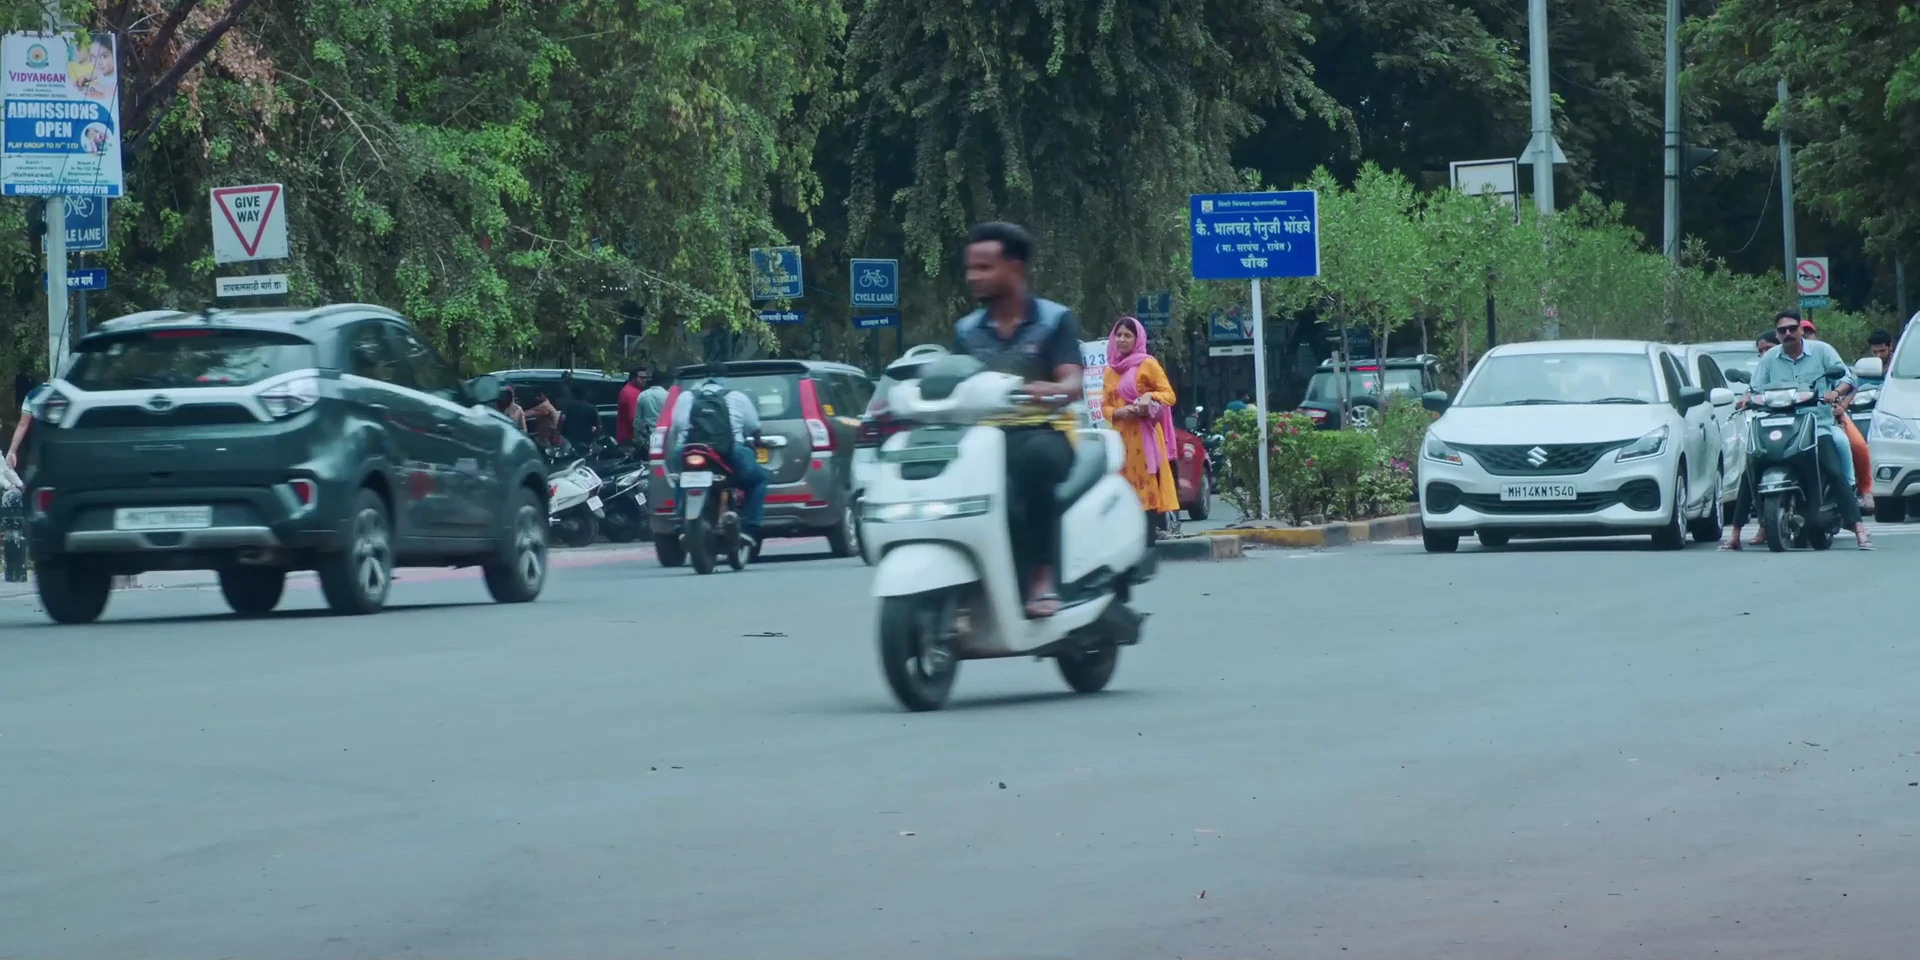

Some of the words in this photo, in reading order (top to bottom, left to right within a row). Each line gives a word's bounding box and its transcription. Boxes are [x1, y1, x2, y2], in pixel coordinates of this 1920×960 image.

[9, 70, 66, 83] VIDYANGAN
[7, 101, 99, 120] ADMISSIONS
[35, 121, 72, 138] OPEN
[235, 196, 260, 208] GIVE
[237, 210, 260, 222] WAY
[78, 228, 101, 241] LANE
[1195, 218, 1211, 236] कै.
[1214, 217, 1252, 237] भालचंद्र
[1253, 216, 1281, 240] गेनुजी
[1283, 216, 1311, 234] भोंडवे
[1236, 241, 1259, 252] सरपंच
[1240, 253, 1268, 268] चौक
[81, 272, 93, 286] मार्ग
[261, 278, 272, 290] मार्ग
[855, 293, 875, 301] CYCLE
[876, 293, 894, 301] LANE
[1508, 486, 1574, 498] MH14KN1540
